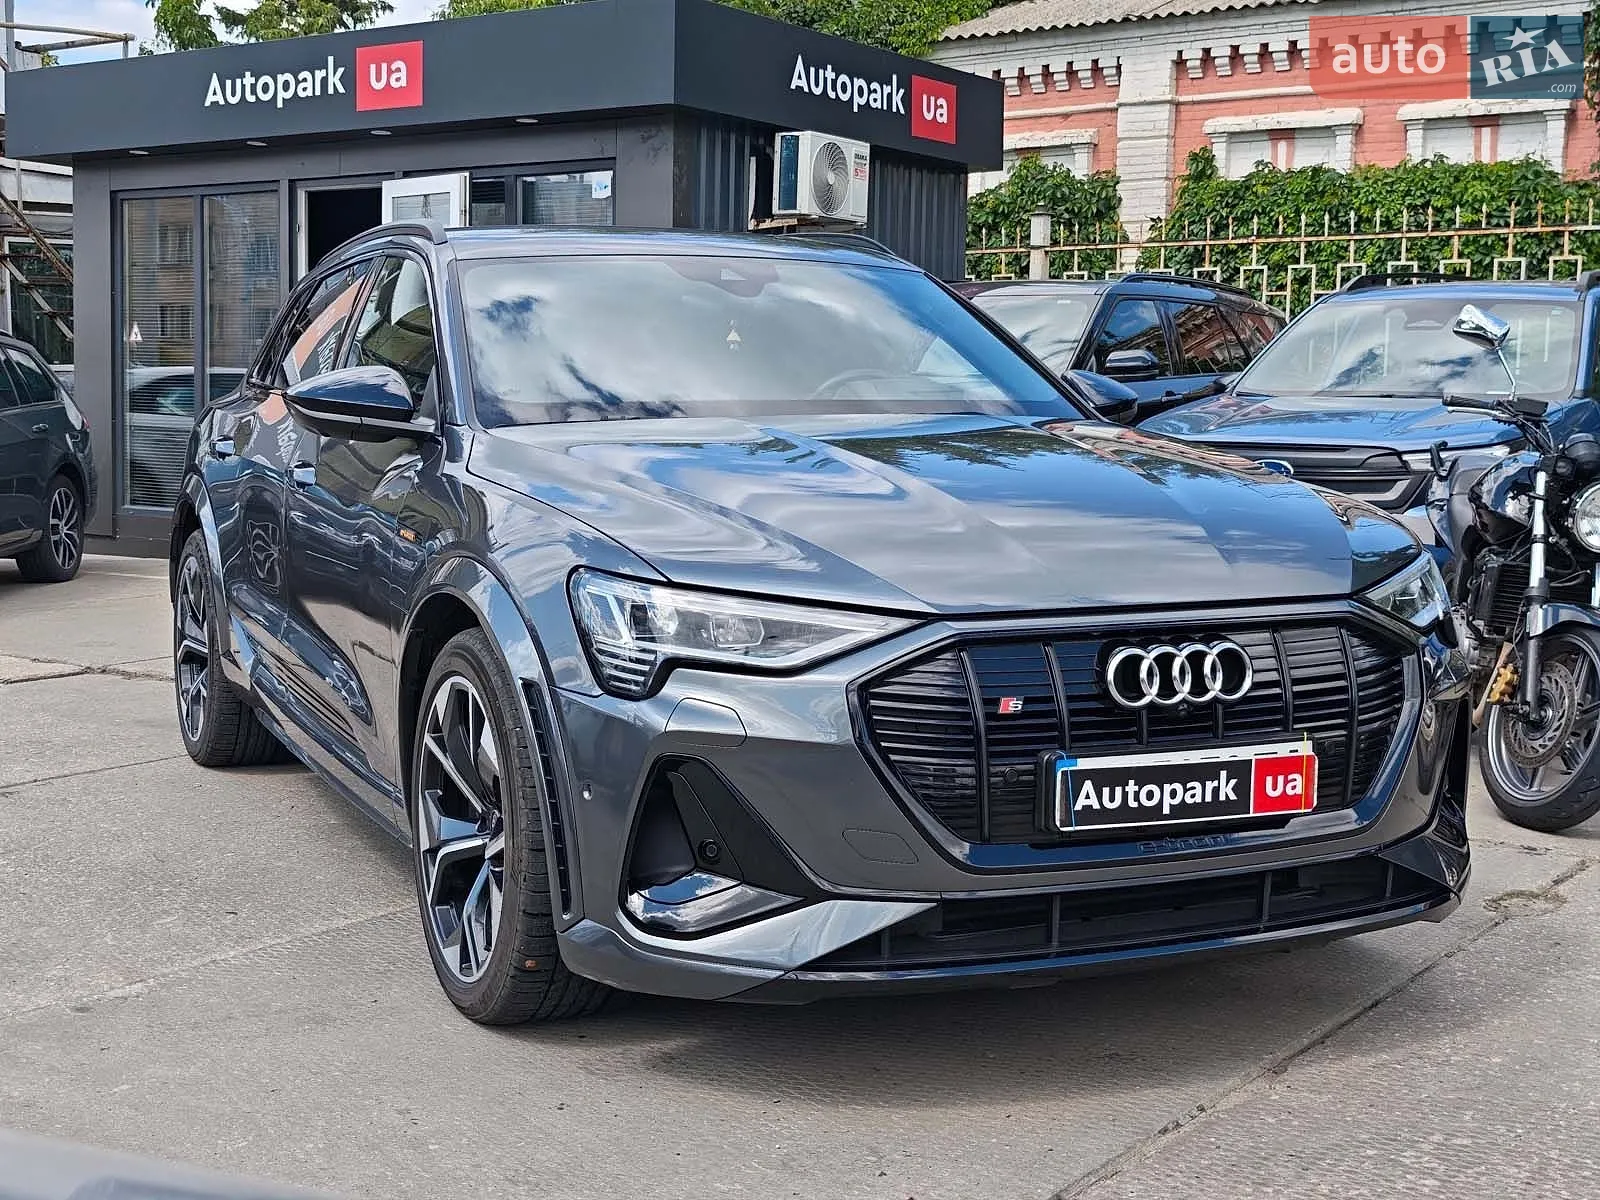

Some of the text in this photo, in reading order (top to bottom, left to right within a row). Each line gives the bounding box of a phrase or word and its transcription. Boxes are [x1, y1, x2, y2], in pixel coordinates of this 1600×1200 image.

[204, 56, 408, 108] Autopark ua
[790, 54, 949, 124] Autopark ua
[1074, 771, 1303, 814] Autopark ua
